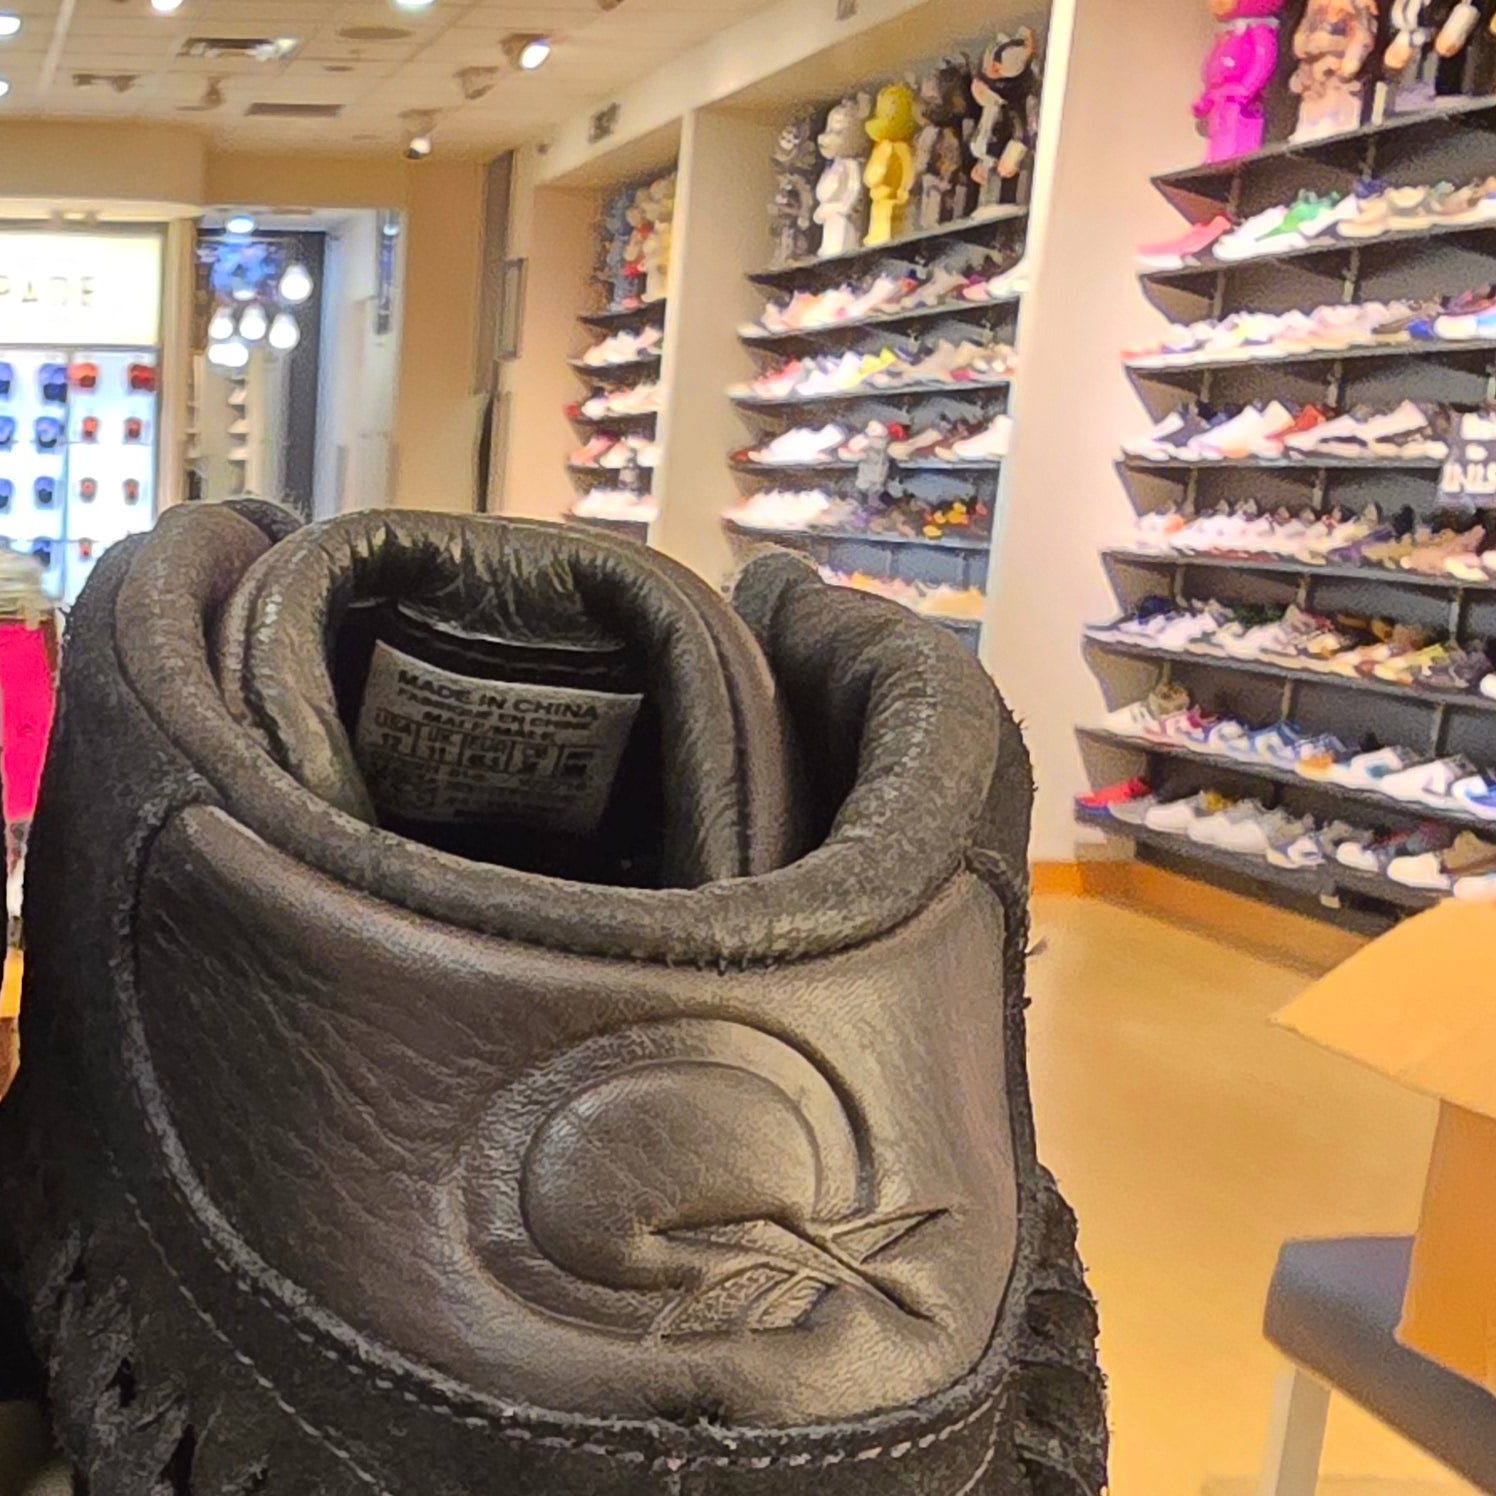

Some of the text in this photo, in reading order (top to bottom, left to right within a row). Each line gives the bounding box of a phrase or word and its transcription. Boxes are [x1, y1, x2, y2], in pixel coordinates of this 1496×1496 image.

[397, 669, 599, 721] MADE IN CHINA
